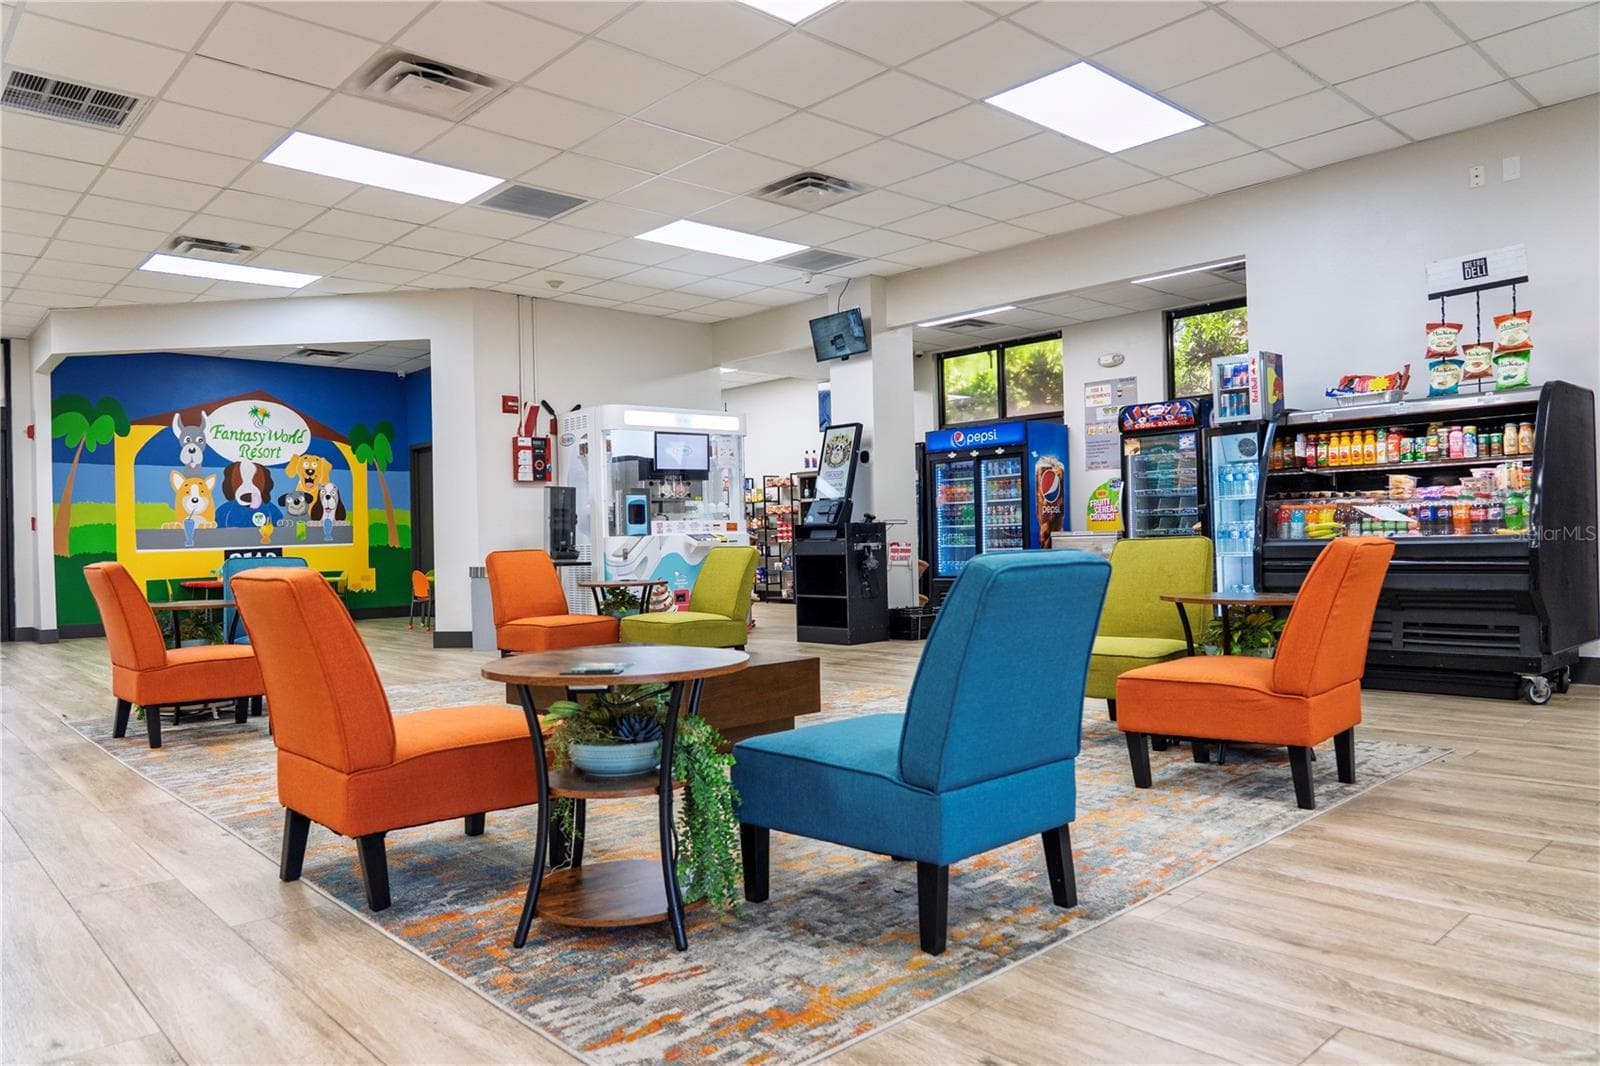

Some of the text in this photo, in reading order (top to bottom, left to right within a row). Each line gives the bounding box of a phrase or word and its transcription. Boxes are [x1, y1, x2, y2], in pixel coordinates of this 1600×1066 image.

[1464, 265, 1487, 279] DELI
[1134, 419, 1180, 430] COOL ZONE
[209, 424, 307, 447] Fantasy World
[966, 428, 998, 445] pepsi
[239, 443, 281, 461] Resort
[1042, 504, 1061, 514] pepsi
[1090, 512, 1115, 521] CRUNCH
